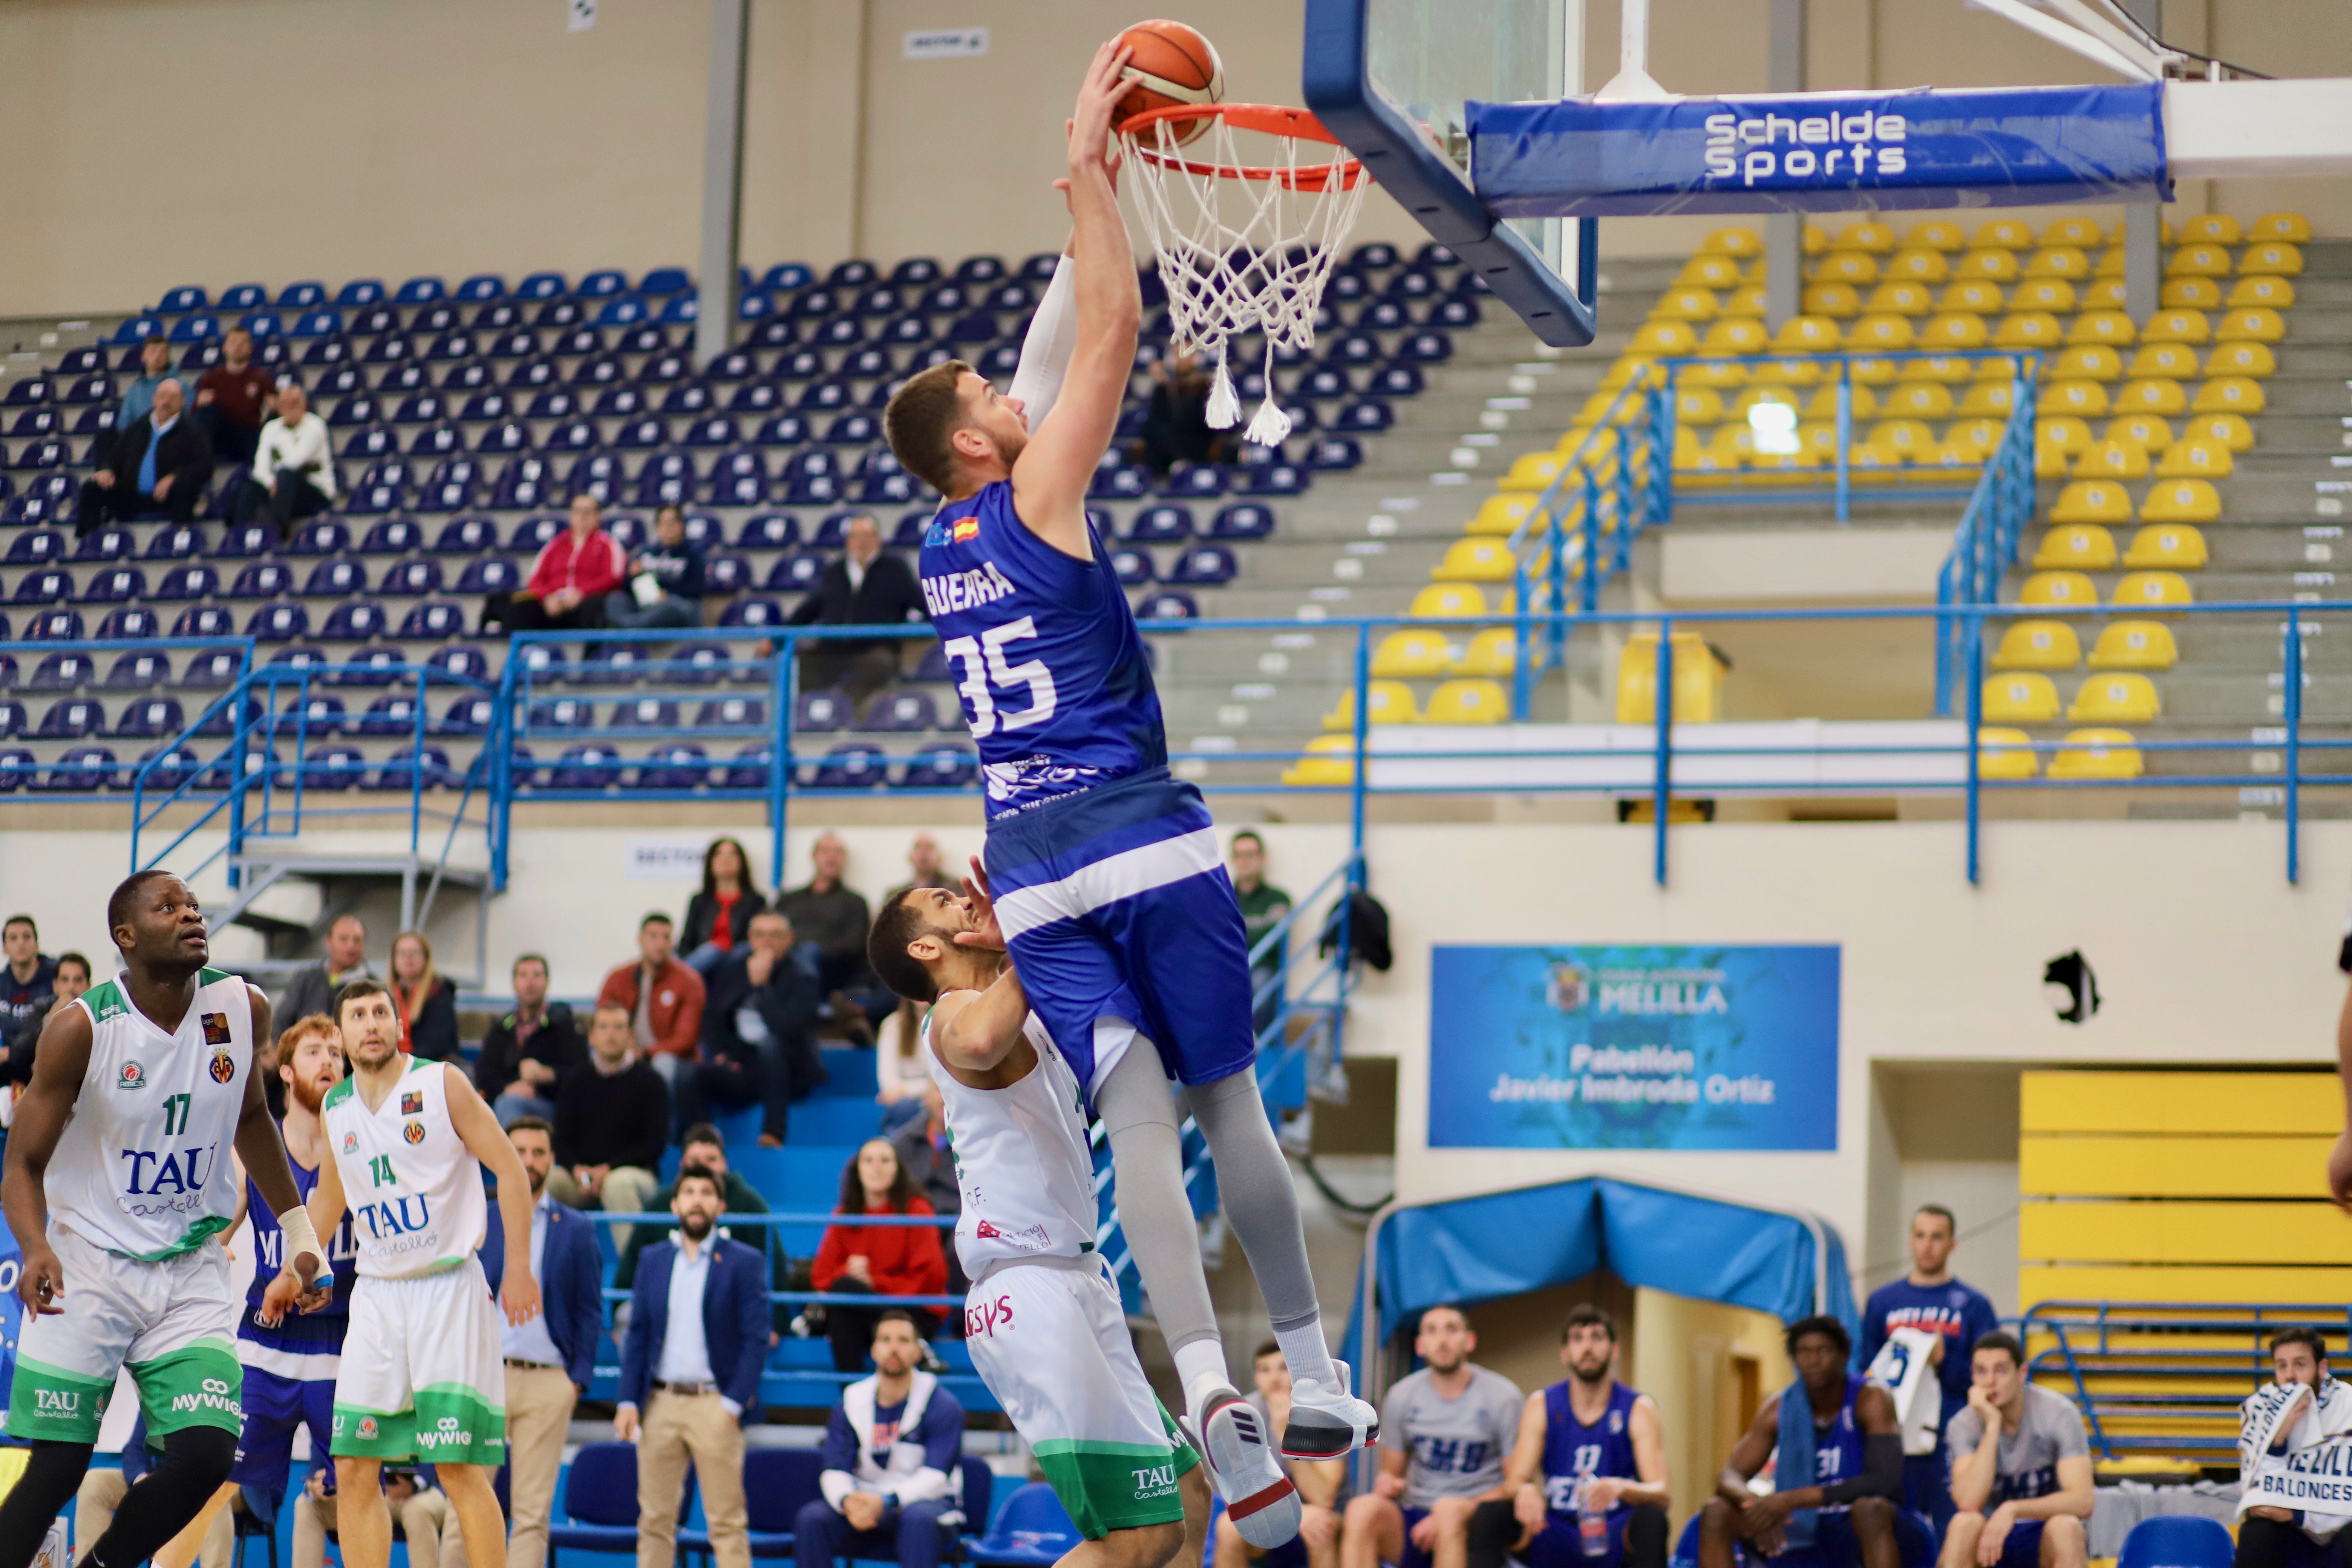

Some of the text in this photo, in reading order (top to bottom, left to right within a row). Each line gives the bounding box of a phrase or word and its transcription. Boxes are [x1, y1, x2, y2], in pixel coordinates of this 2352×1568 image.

[1705, 110, 1906, 145] Schelde
[1705, 142, 1907, 187] Sports
[921, 561, 1016, 617] GUERRA
[944, 615, 1057, 739] 35
[1599, 982, 1728, 1013] MELILLA
[1570, 1044, 1694, 1074] Pabellón
[1489, 1073, 1775, 1104] Javier Imbroda Ortiz
[162, 1093, 190, 1135] 17
[121, 1141, 217, 1194] TAU
[369, 1154, 396, 1187] 14
[358, 1192, 429, 1239] TAU
[369, 1232, 438, 1257] Castelló
[34, 1409, 78, 1419] Castelló
[35, 1389, 80, 1411] TAU
[1132, 1464, 1174, 1489] TAU
[1135, 1484, 1178, 1499] Castelló
